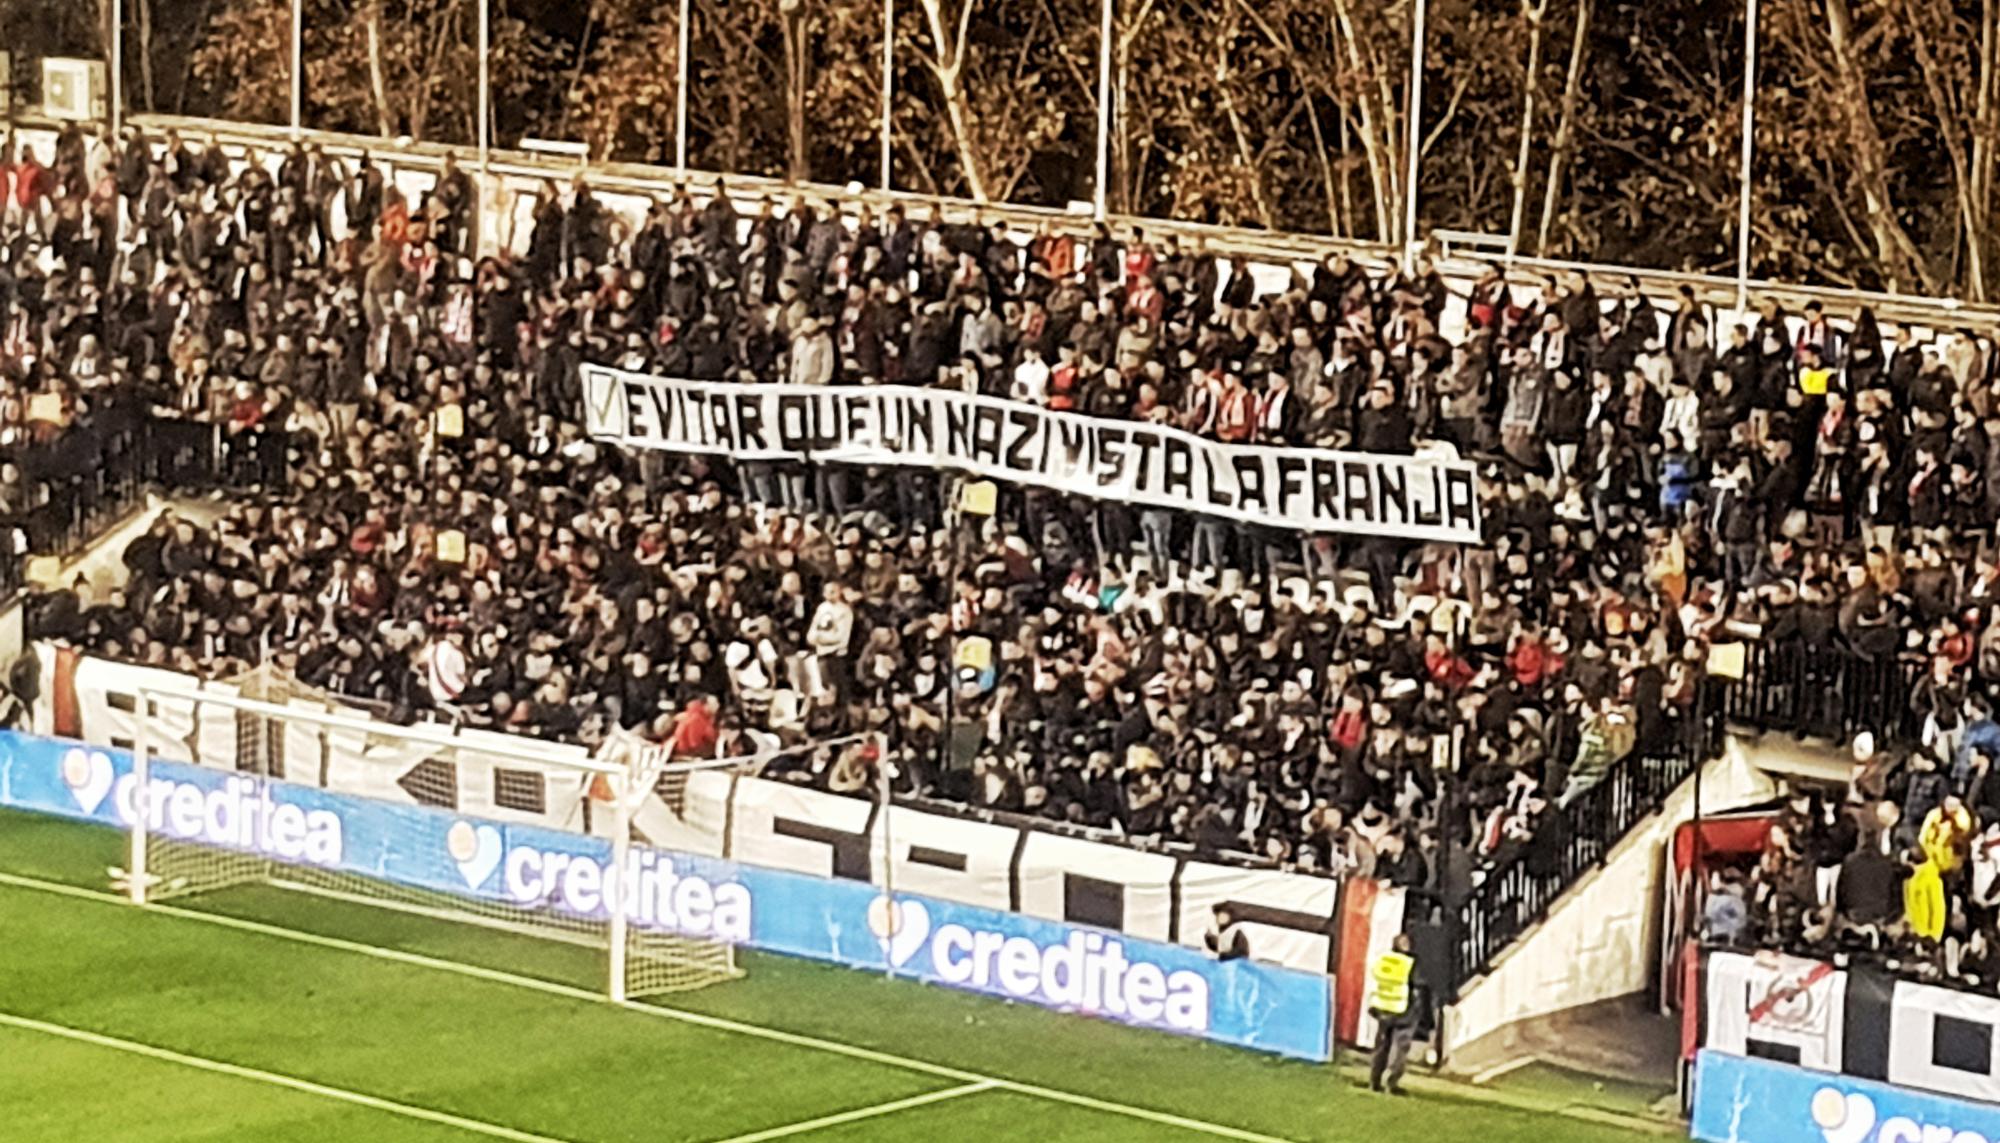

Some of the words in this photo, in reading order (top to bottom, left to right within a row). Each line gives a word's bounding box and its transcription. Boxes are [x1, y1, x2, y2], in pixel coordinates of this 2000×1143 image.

[627, 383, 767, 450] EVITAR
[778, 395, 874, 452] QUE
[878, 396, 933, 454] UN
[945, 402, 1051, 473] NAZI
[1061, 419, 1193, 499] VISTA
[1203, 448, 1269, 511] LA
[1279, 457, 1475, 530] FRANJA
[116, 771, 343, 864] creditea
[507, 843, 752, 941] creditea
[932, 922, 1209, 1030] creditea
